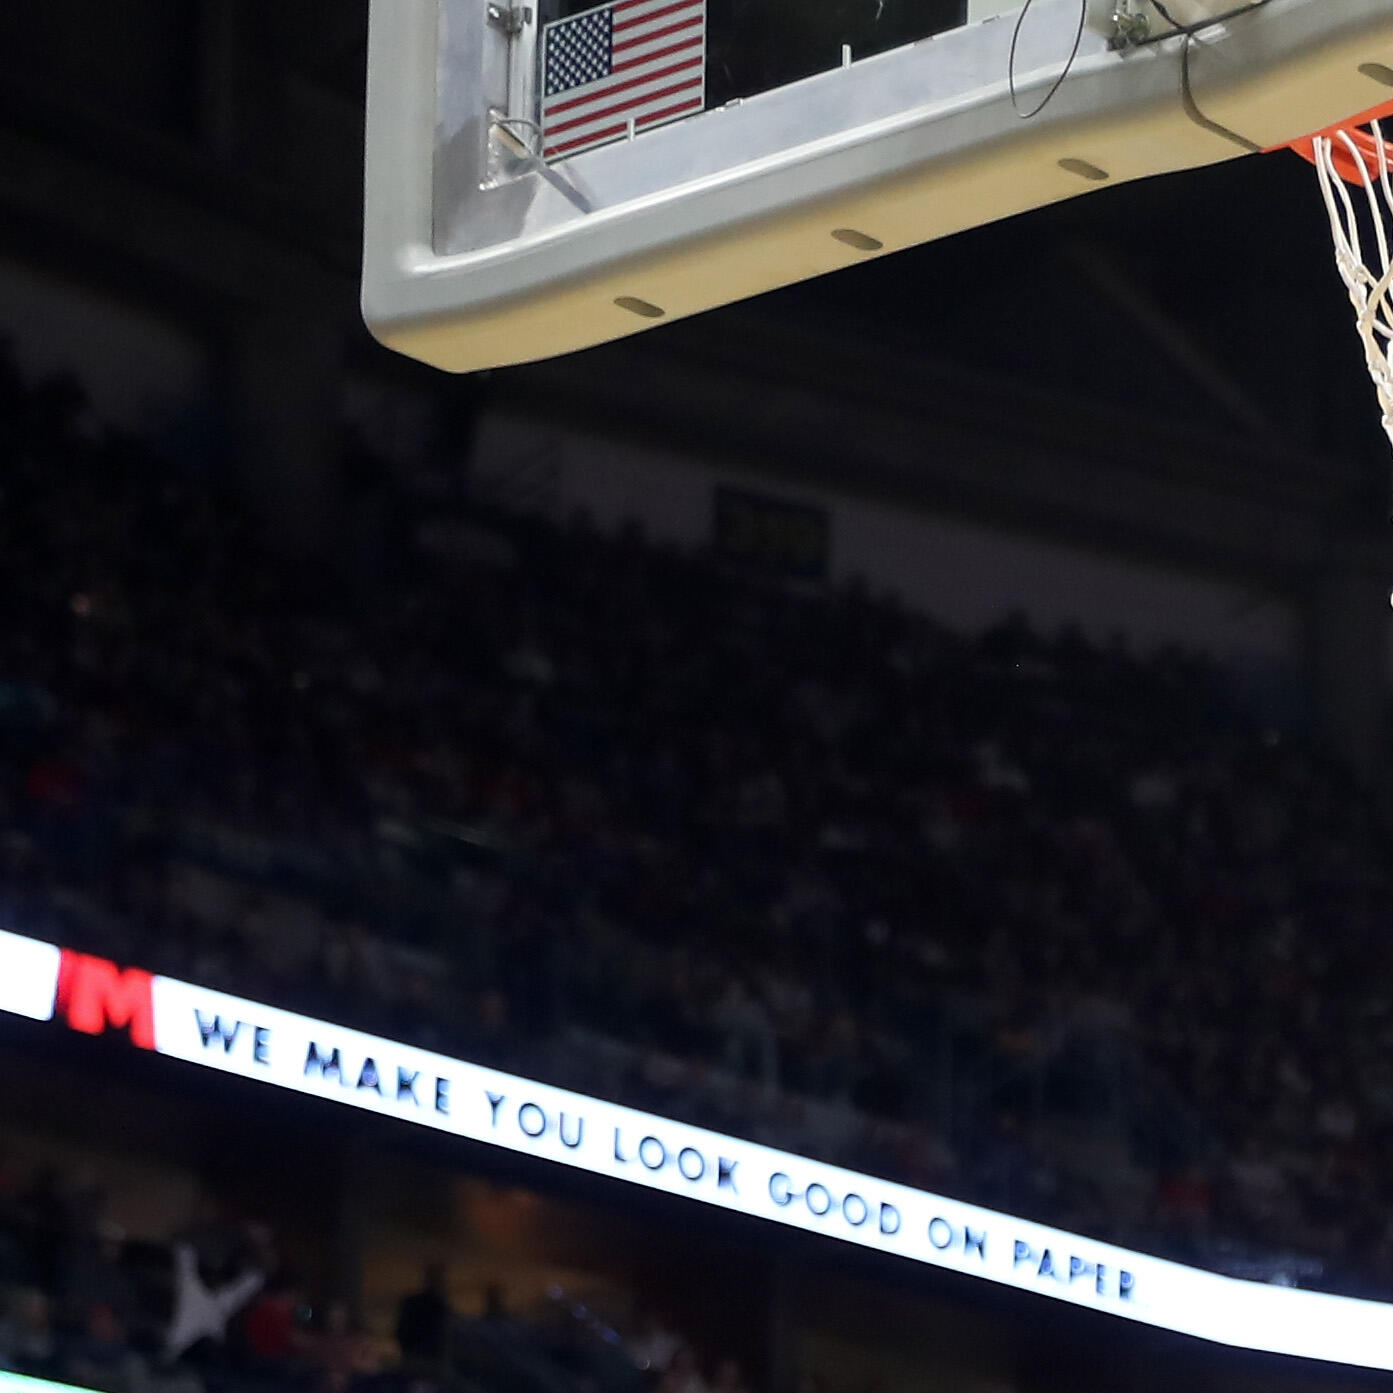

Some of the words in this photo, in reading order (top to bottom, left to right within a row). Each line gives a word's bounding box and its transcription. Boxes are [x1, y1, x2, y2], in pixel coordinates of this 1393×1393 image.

[194, 1008, 272, 1065] WE
[303, 1040, 451, 1115] MAKE
[485, 1089, 585, 1150] YOU
[612, 1127, 740, 1194] LOOK
[767, 1171, 902, 1236] GOOD
[928, 1216, 987, 1261] ON
